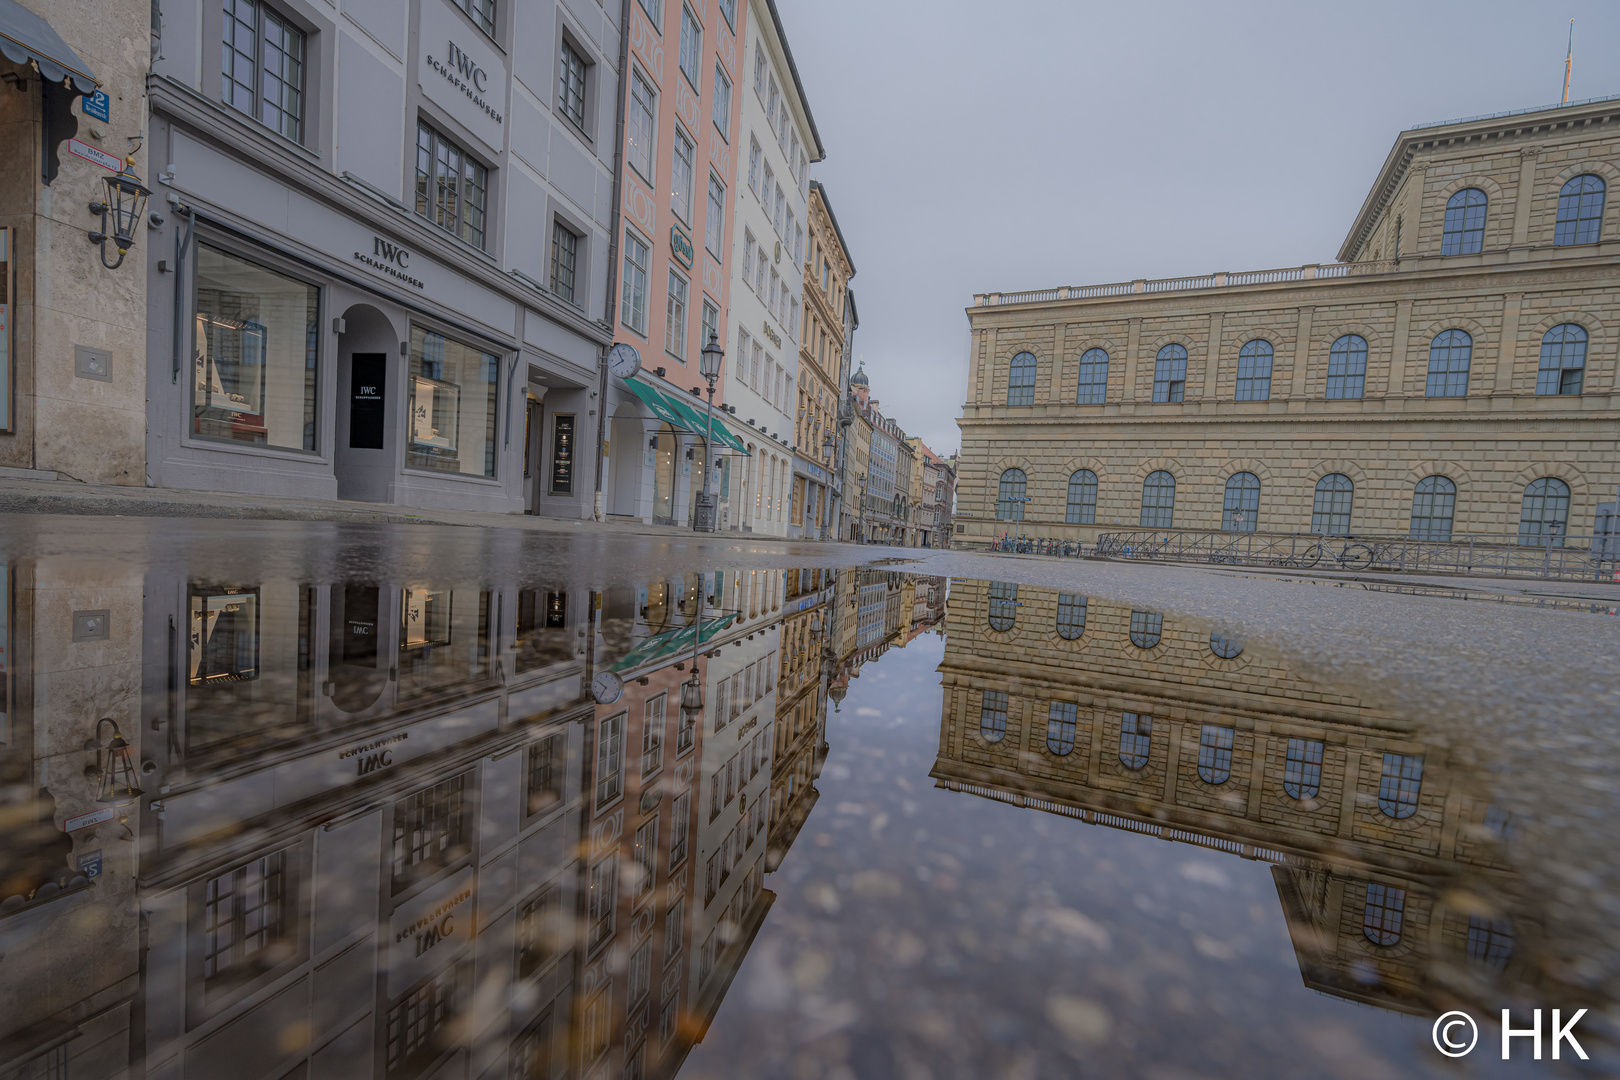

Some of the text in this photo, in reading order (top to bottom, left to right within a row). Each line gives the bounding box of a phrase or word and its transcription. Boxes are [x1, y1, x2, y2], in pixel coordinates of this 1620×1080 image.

[448, 40, 487, 93] IWC
[427, 54, 502, 124] SCHAFFHAUSEN
[88, 148, 104, 159] BMZ
[373, 236, 409, 269] IWC
[354, 252, 424, 289] SCHAFFHAUSEN
[360, 386, 376, 395] IWC
